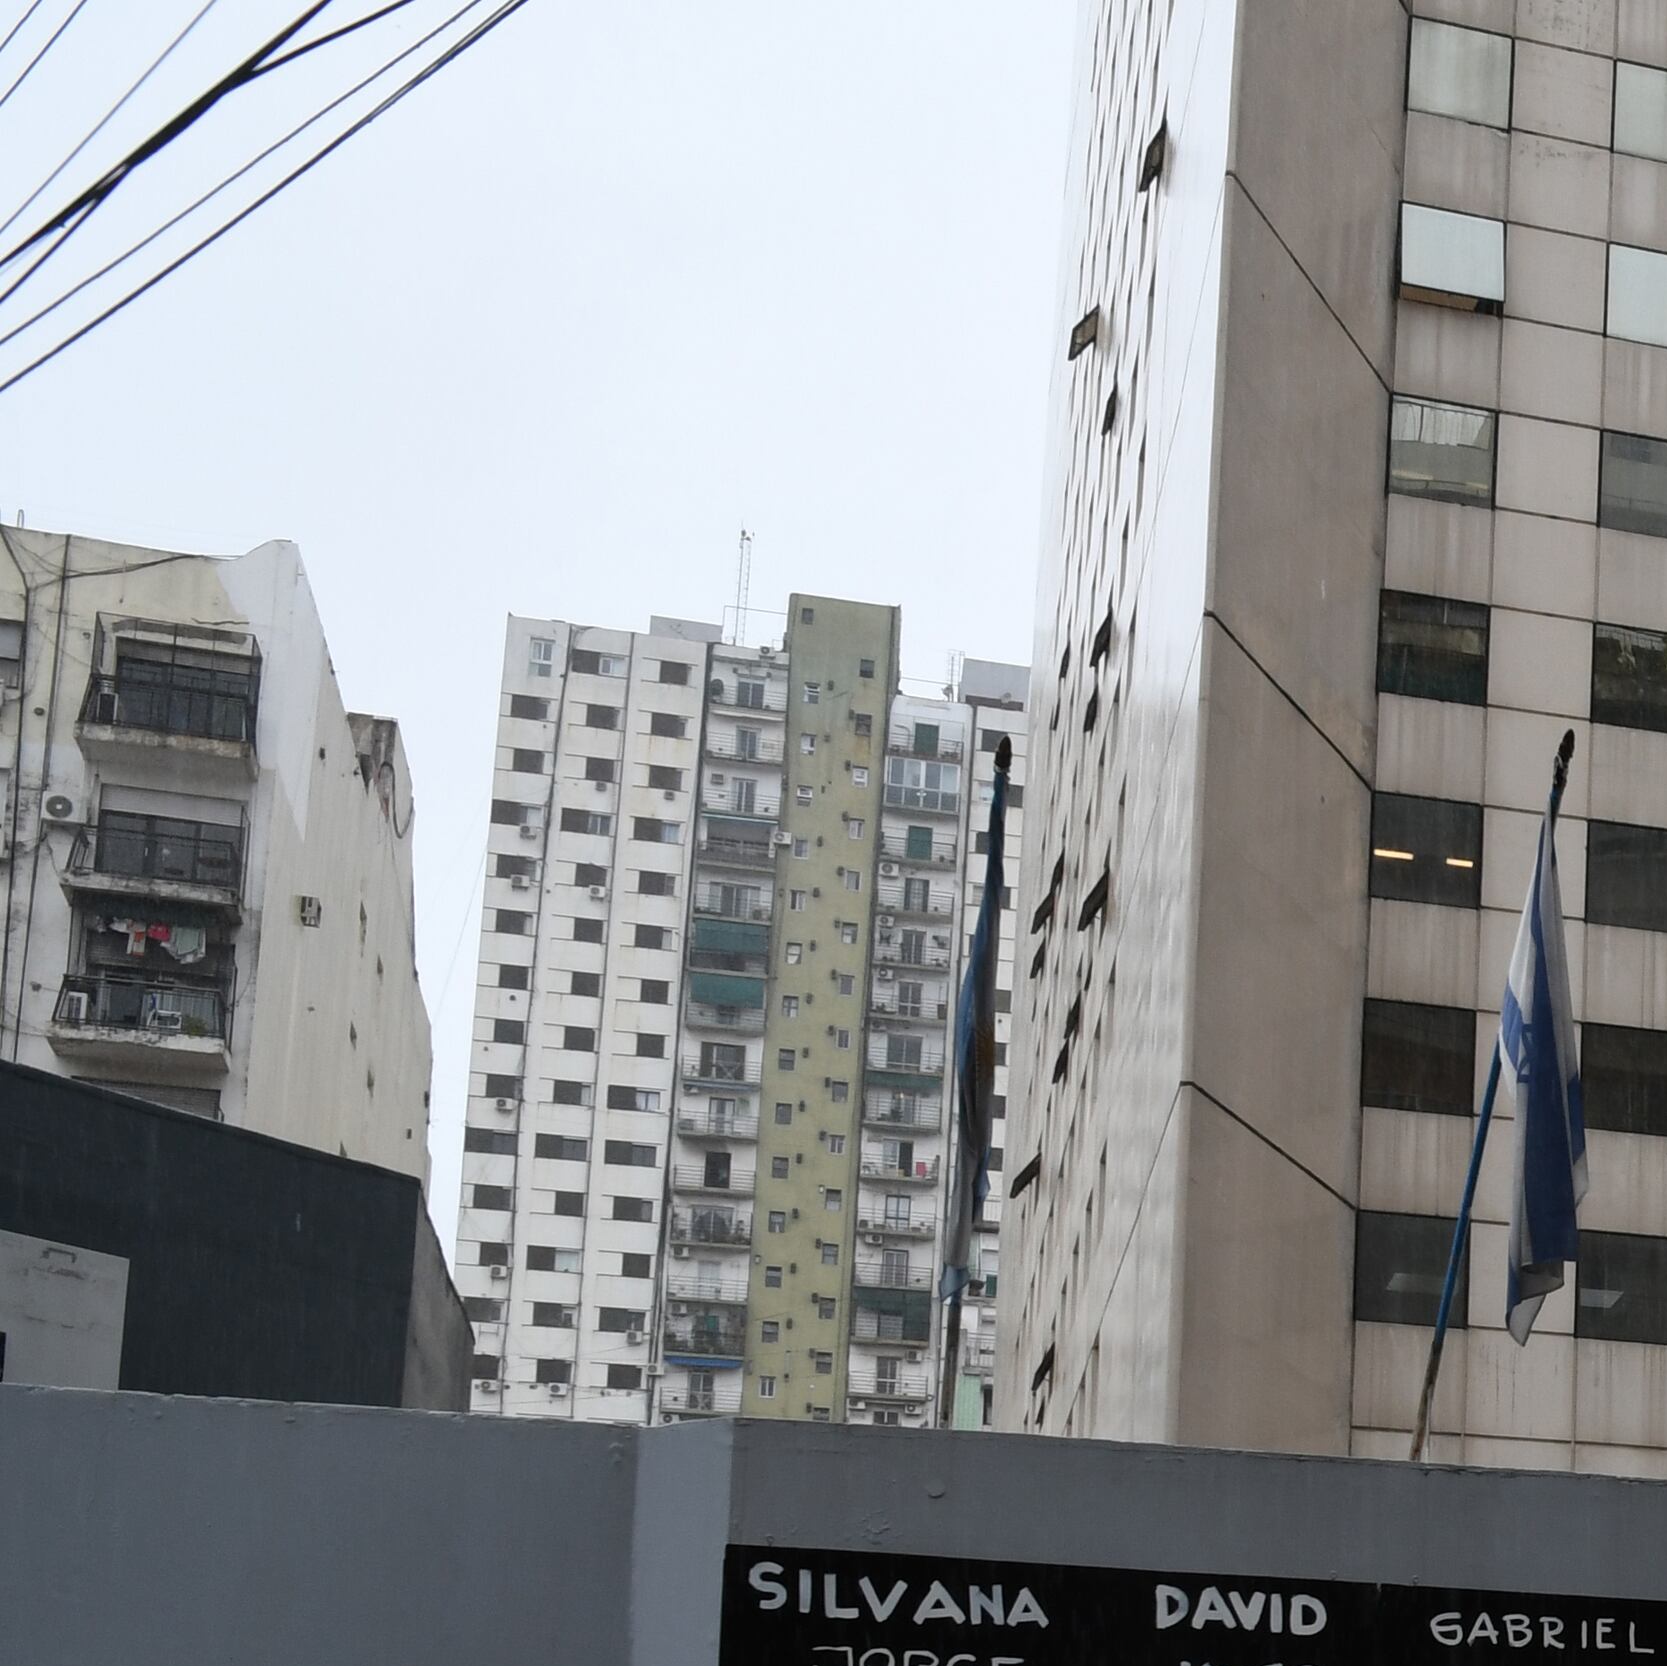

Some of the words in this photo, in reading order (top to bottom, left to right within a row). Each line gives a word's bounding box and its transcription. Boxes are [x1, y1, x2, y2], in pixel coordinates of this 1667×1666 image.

[748, 1561, 1049, 1629] SILVANA
[1155, 1584, 1328, 1636] DAVID
[1429, 1612, 1655, 1654] GABRIEL
